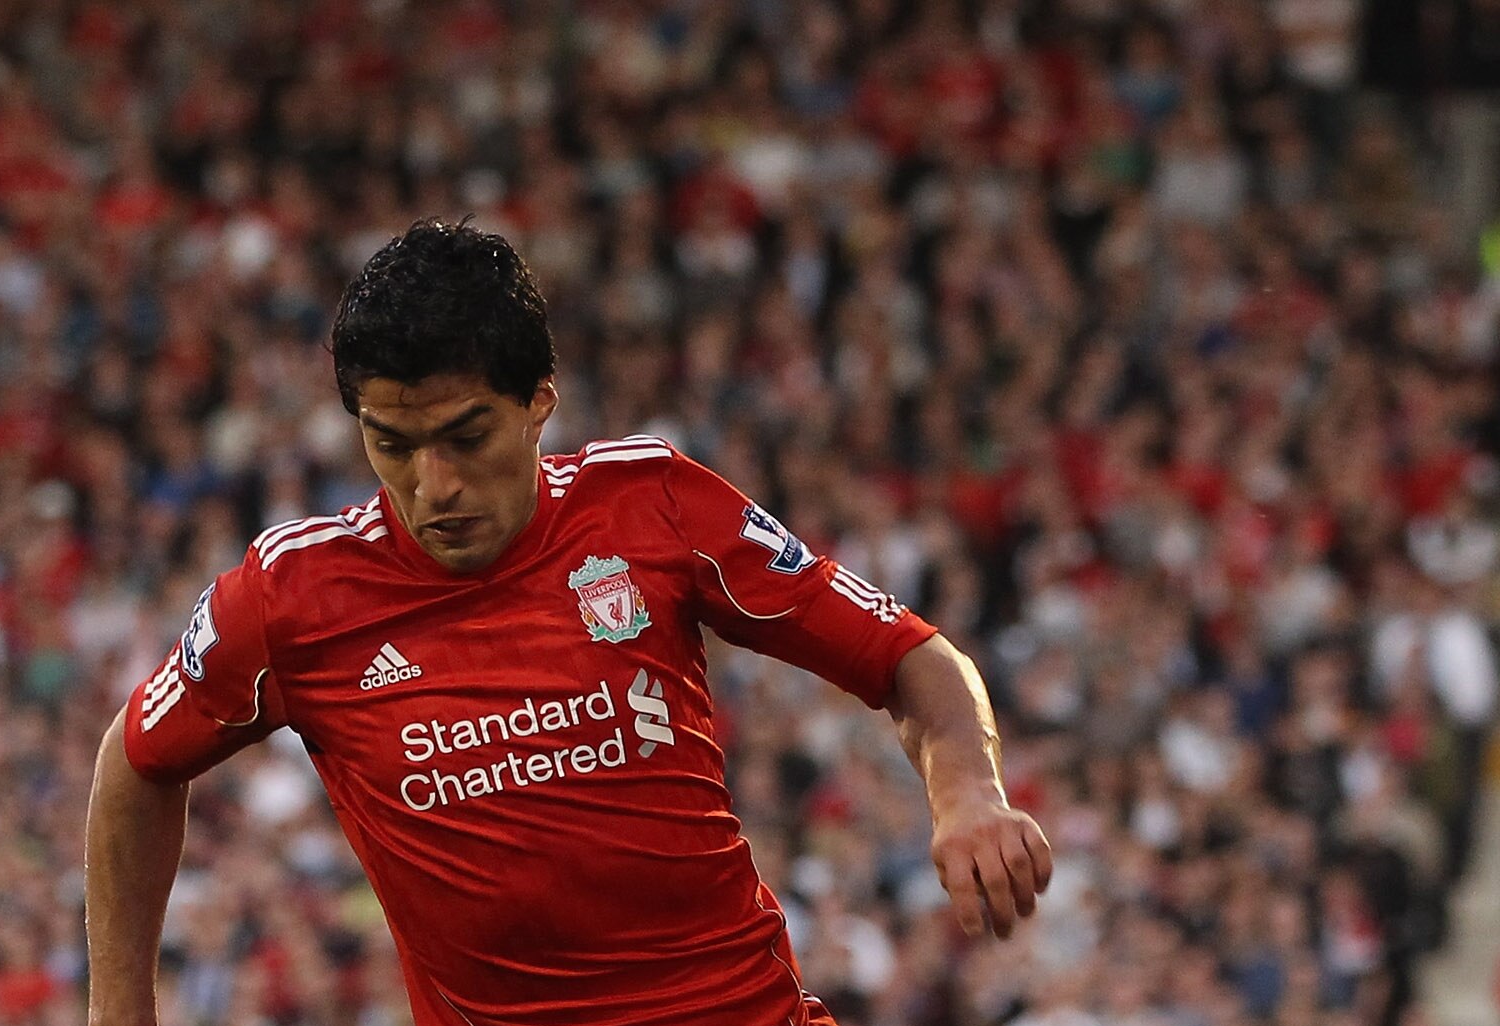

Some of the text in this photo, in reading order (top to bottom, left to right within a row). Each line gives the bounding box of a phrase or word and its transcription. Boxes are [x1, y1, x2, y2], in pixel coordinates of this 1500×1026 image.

[584, 578, 627, 599] LIVERPOOL
[359, 664, 423, 691] adidas
[400, 680, 617, 763] Standard
[399, 727, 627, 812] Chartered
